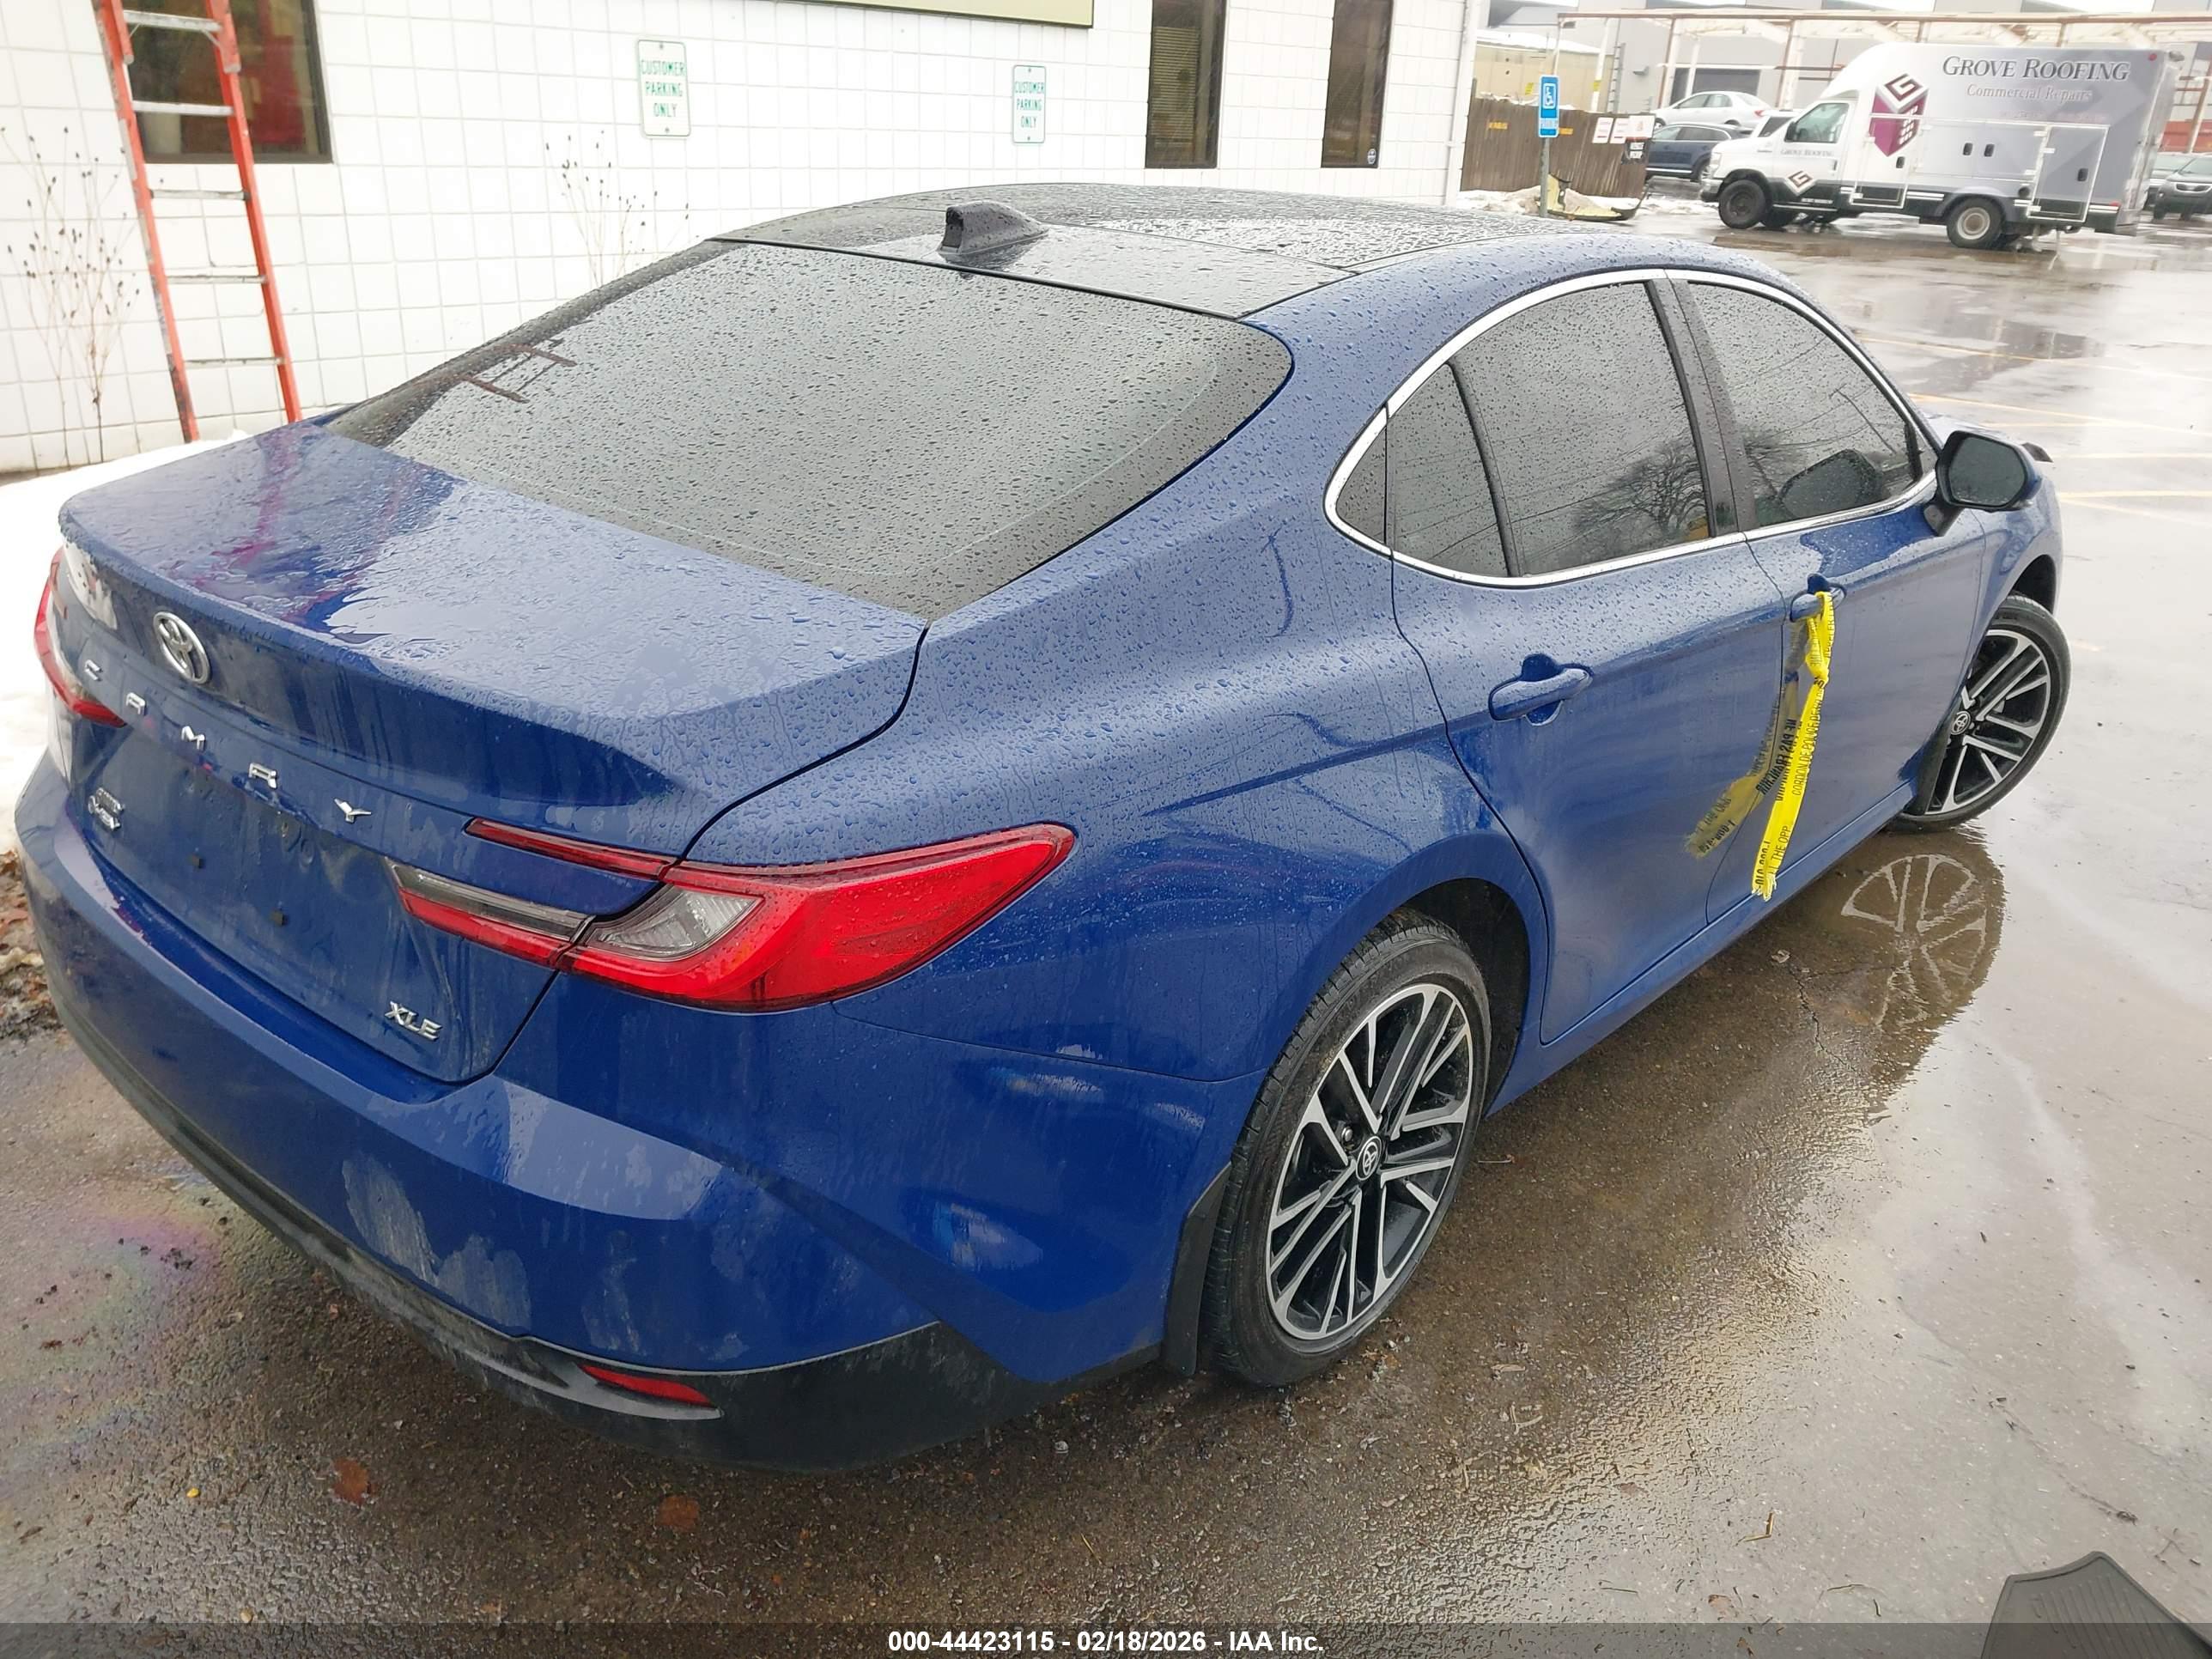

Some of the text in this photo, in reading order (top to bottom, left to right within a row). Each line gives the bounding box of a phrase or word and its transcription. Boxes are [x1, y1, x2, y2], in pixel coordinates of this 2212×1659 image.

[641, 60, 686, 76] CUSTOMER
[1942, 55, 2130, 81] GROVE ROOFING
[645, 82, 683, 96] PARKING
[1015, 81, 1045, 94] CUSTOMER
[1966, 83, 2040, 100] Commercial
[653, 102, 678, 118] ONLY
[1016, 98, 1042, 111] PARKING
[1020, 115, 1038, 128] ONLY
[84, 659, 372, 823] CAMRY
[1791, 762, 1810, 796] CORDON
[1778, 825, 1791, 844] OPP
[1771, 845, 1787, 861] THE
[384, 1000, 443, 1042] XLE
